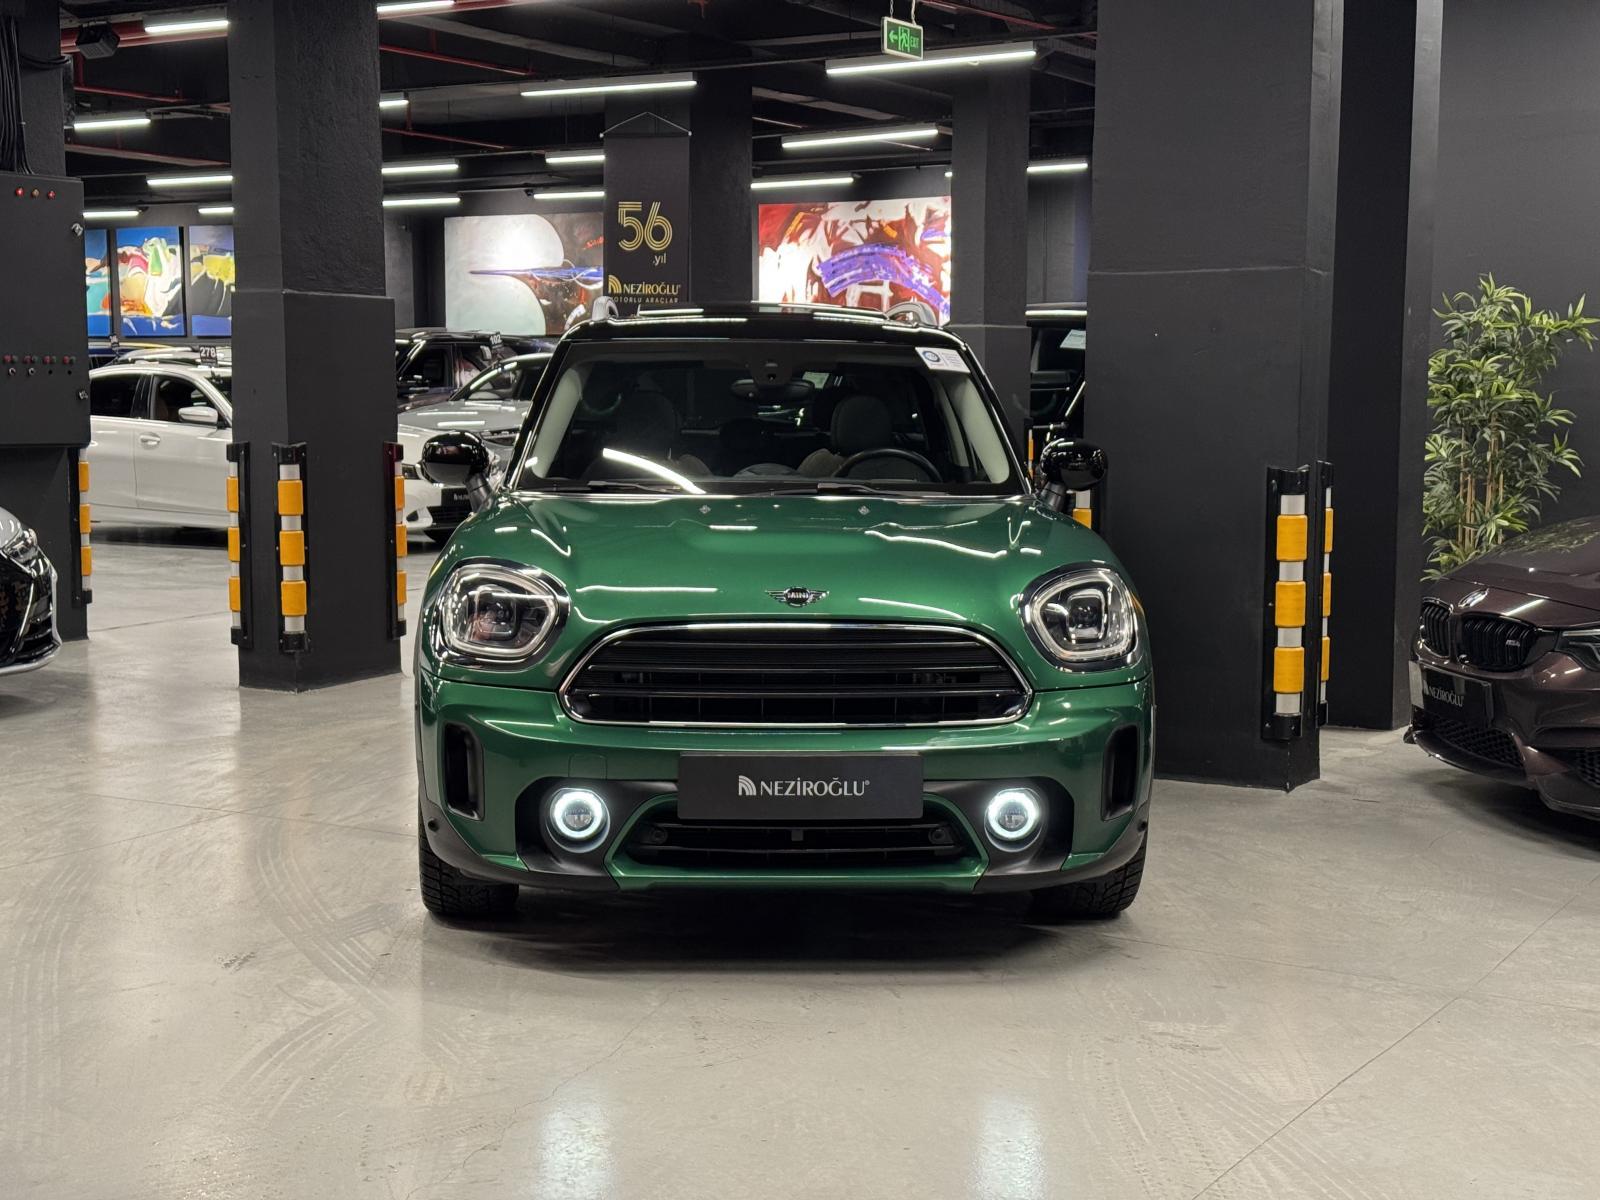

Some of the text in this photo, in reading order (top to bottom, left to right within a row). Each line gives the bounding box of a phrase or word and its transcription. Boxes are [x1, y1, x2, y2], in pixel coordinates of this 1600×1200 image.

[910, 36, 919, 48] EXIT
[618, 201, 673, 251] 56
[200, 346, 216, 358] 278
